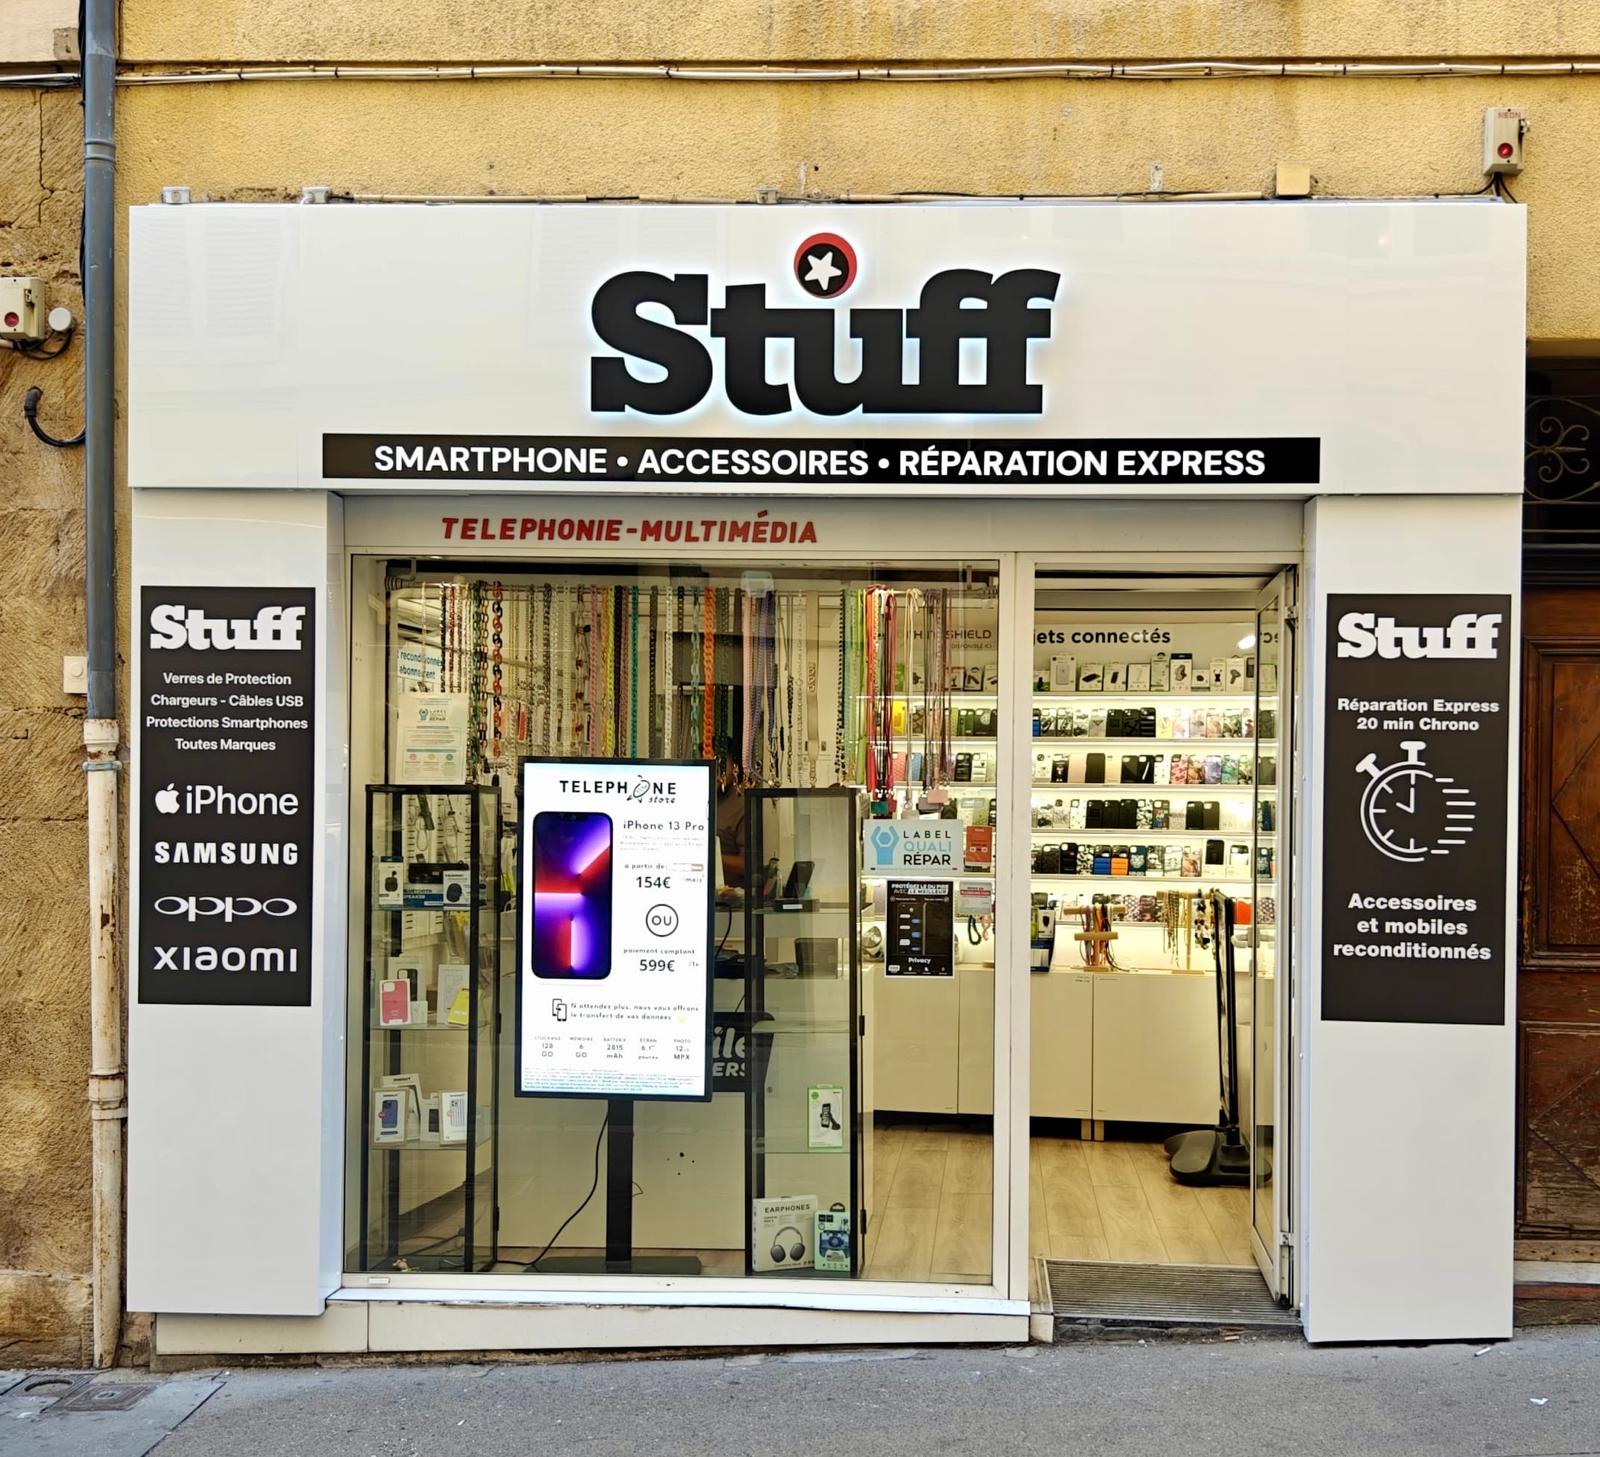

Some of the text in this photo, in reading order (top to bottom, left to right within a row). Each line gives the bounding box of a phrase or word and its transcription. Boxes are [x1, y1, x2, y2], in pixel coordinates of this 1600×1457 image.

[590, 267, 1061, 416] Stuff
[374, 446, 1266, 477] SMARTPHONE ACCESSOIRES RÉPARATION EXPRESS
[442, 511, 818, 543] TELEPHONIE-MULTIMÉDIA
[149, 604, 306, 651] Stuff
[1071, 627, 1171, 644] connectés
[1336, 612, 1503, 660] Stuff
[162, 672, 292, 686] Verres de Protection
[150, 694, 218, 708] Chargeurs
[228, 693, 275, 708] Câbles
[275, 695, 305, 708] USB
[1337, 698, 1501, 717] Réparation Express
[146, 716, 309, 731] Protections Smartphones
[1356, 717, 1480, 732] 20 min Chrono
[174, 738, 276, 752] Toutes Marques
[185, 785, 300, 817] iPhone
[648, 796, 676, 804] store
[623, 819, 705, 831] iPhone 13 Pro
[903, 830, 952, 839] LABEL
[154, 841, 299, 866] SAMSUNG
[903, 841, 952, 853] QUALI
[903, 851, 951, 866] RÉPAR
[635, 876, 672, 889] 154€
[154, 896, 298, 922] oppo
[1347, 894, 1478, 913] Accessoires
[651, 914, 672, 926] OU
[1356, 918, 1469, 935] et mobiles
[1333, 941, 1493, 961] reconditionnés
[639, 959, 676, 972] 599€
[907, 957, 932, 965] Privacy
[673, 1053, 691, 1061] MPX
[764, 1203, 811, 1214] EARPHONES
